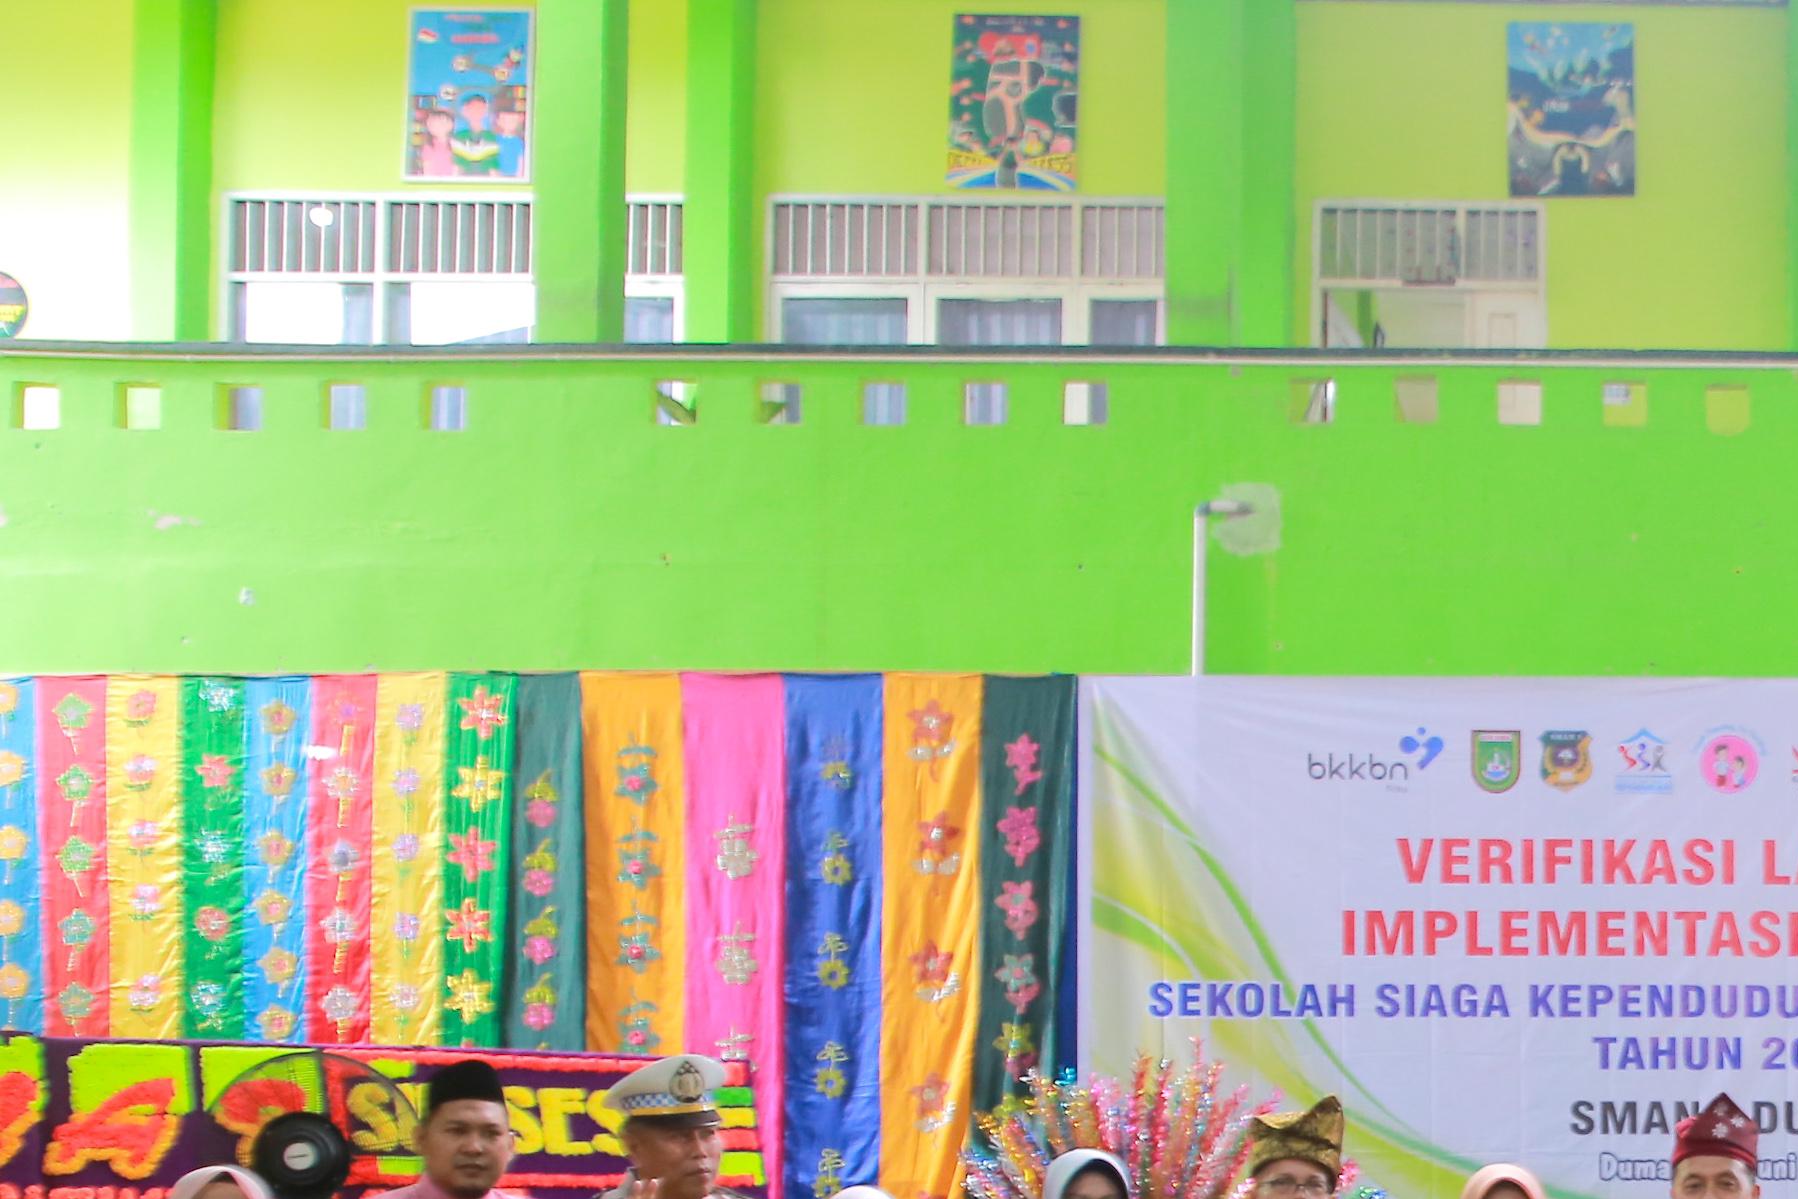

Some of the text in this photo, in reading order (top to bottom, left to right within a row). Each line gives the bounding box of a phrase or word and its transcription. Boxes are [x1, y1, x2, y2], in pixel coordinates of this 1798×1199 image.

[1307, 752, 1409, 781] bkkbn
[1395, 836, 1737, 888] VERIFIKASI
[1148, 981, 1356, 1018] SEKOLAH
[1375, 983, 1511, 1019] SIAGA
[1592, 1036, 1743, 1071] TAHUN
[1569, 1099, 1700, 1136] SMAN
[1599, 1152, 1673, 1181] Duma
[1755, 1152, 1798, 1181] uni
